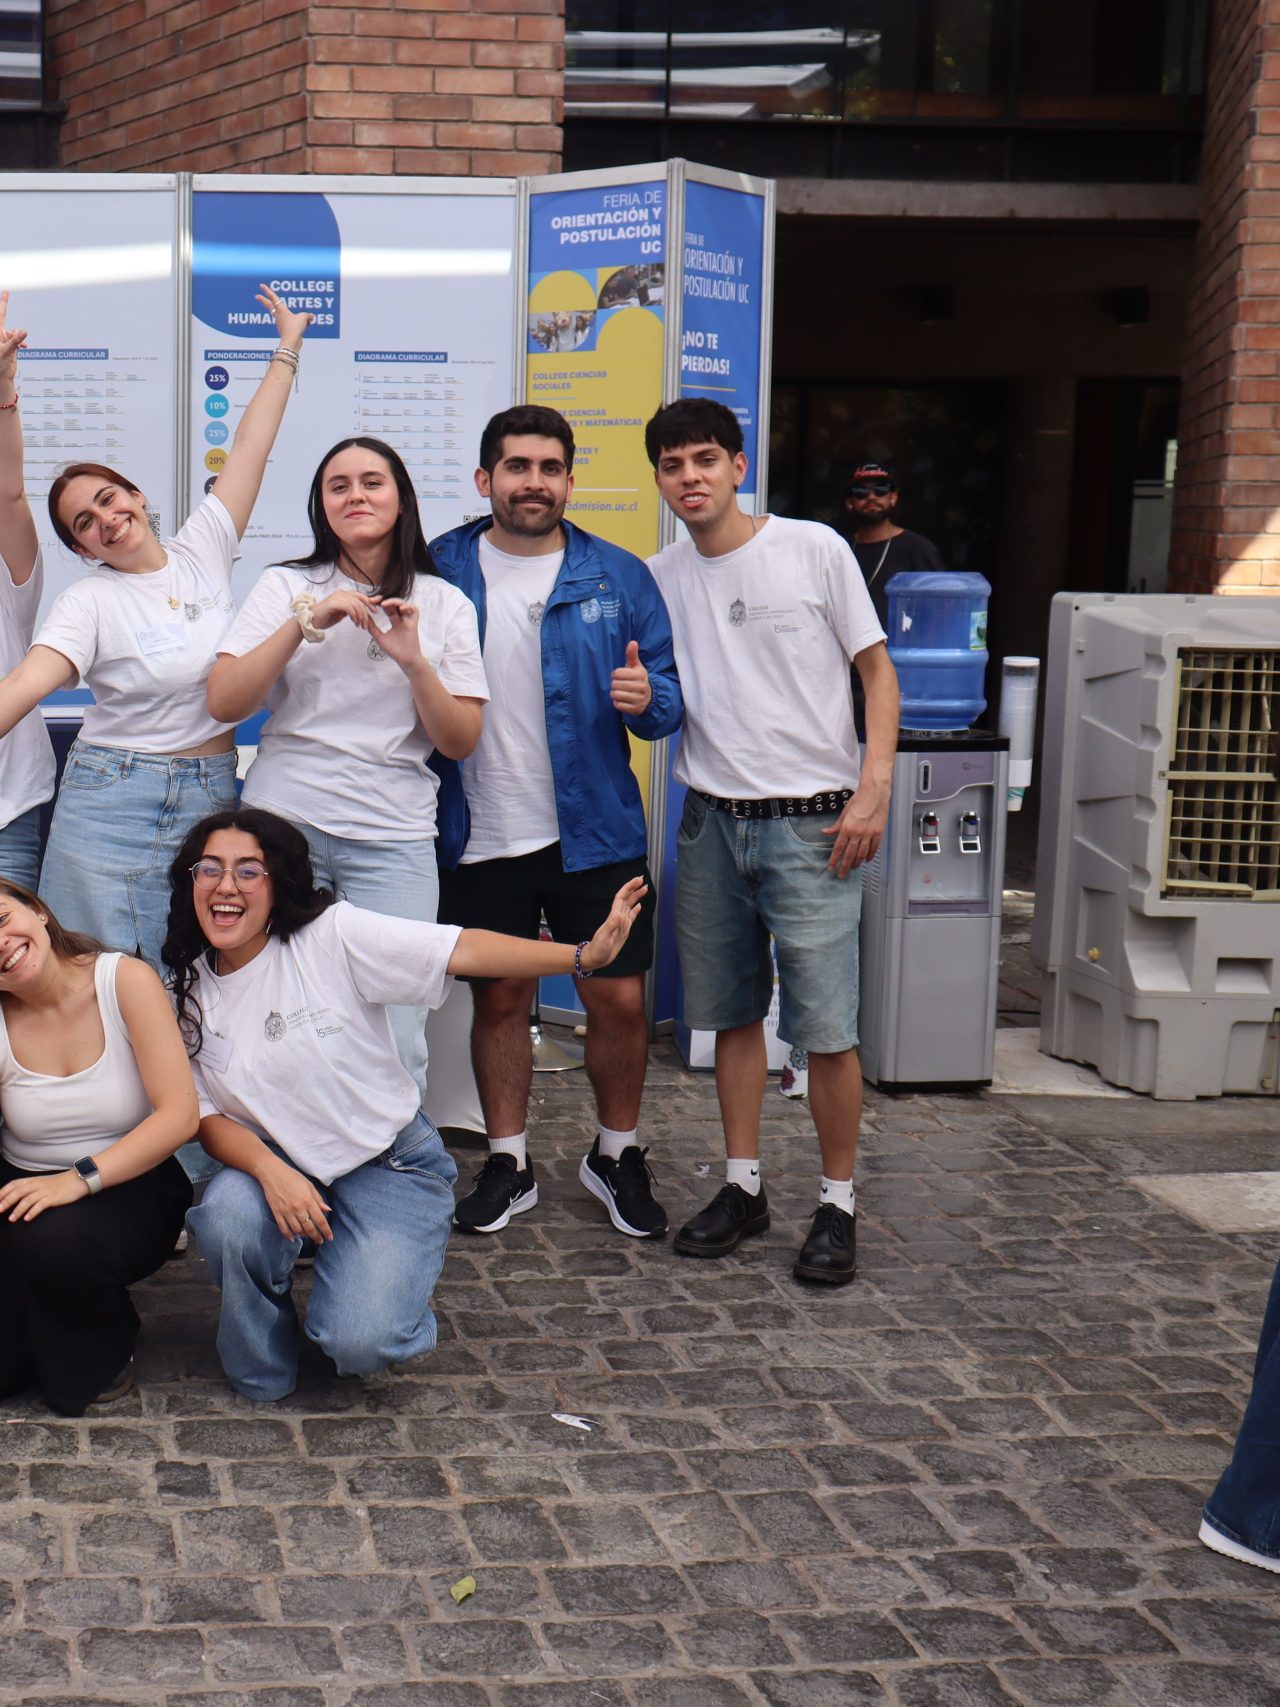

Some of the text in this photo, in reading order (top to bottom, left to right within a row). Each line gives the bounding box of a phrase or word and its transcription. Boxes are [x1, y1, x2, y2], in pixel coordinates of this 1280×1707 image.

[604, 191, 662, 208] FERIA DE
[551, 206, 662, 230] ORIENTACIÓN Y
[560, 223, 662, 244] POSTULACIÓN
[685, 232, 698, 246] FERIA
[640, 241, 662, 254] UC
[684, 247, 744, 277] ORIENTACIÓN Y
[270, 280, 334, 292] COLLEGE
[684, 274, 750, 304] POSTULACIÓN UC
[325, 298, 334, 308] Y
[683, 332, 718, 350] ¡NO TE
[682, 354, 730, 376] PIERDAS!
[209, 374, 226, 382] 25%
[532, 370, 608, 380] COLLEGE CIENCIAS
[532, 382, 572, 391] SOCIALES
[210, 402, 226, 410] 10%
[568, 408, 606, 416] CIENCIAS
[209, 456, 225, 464] 20%
